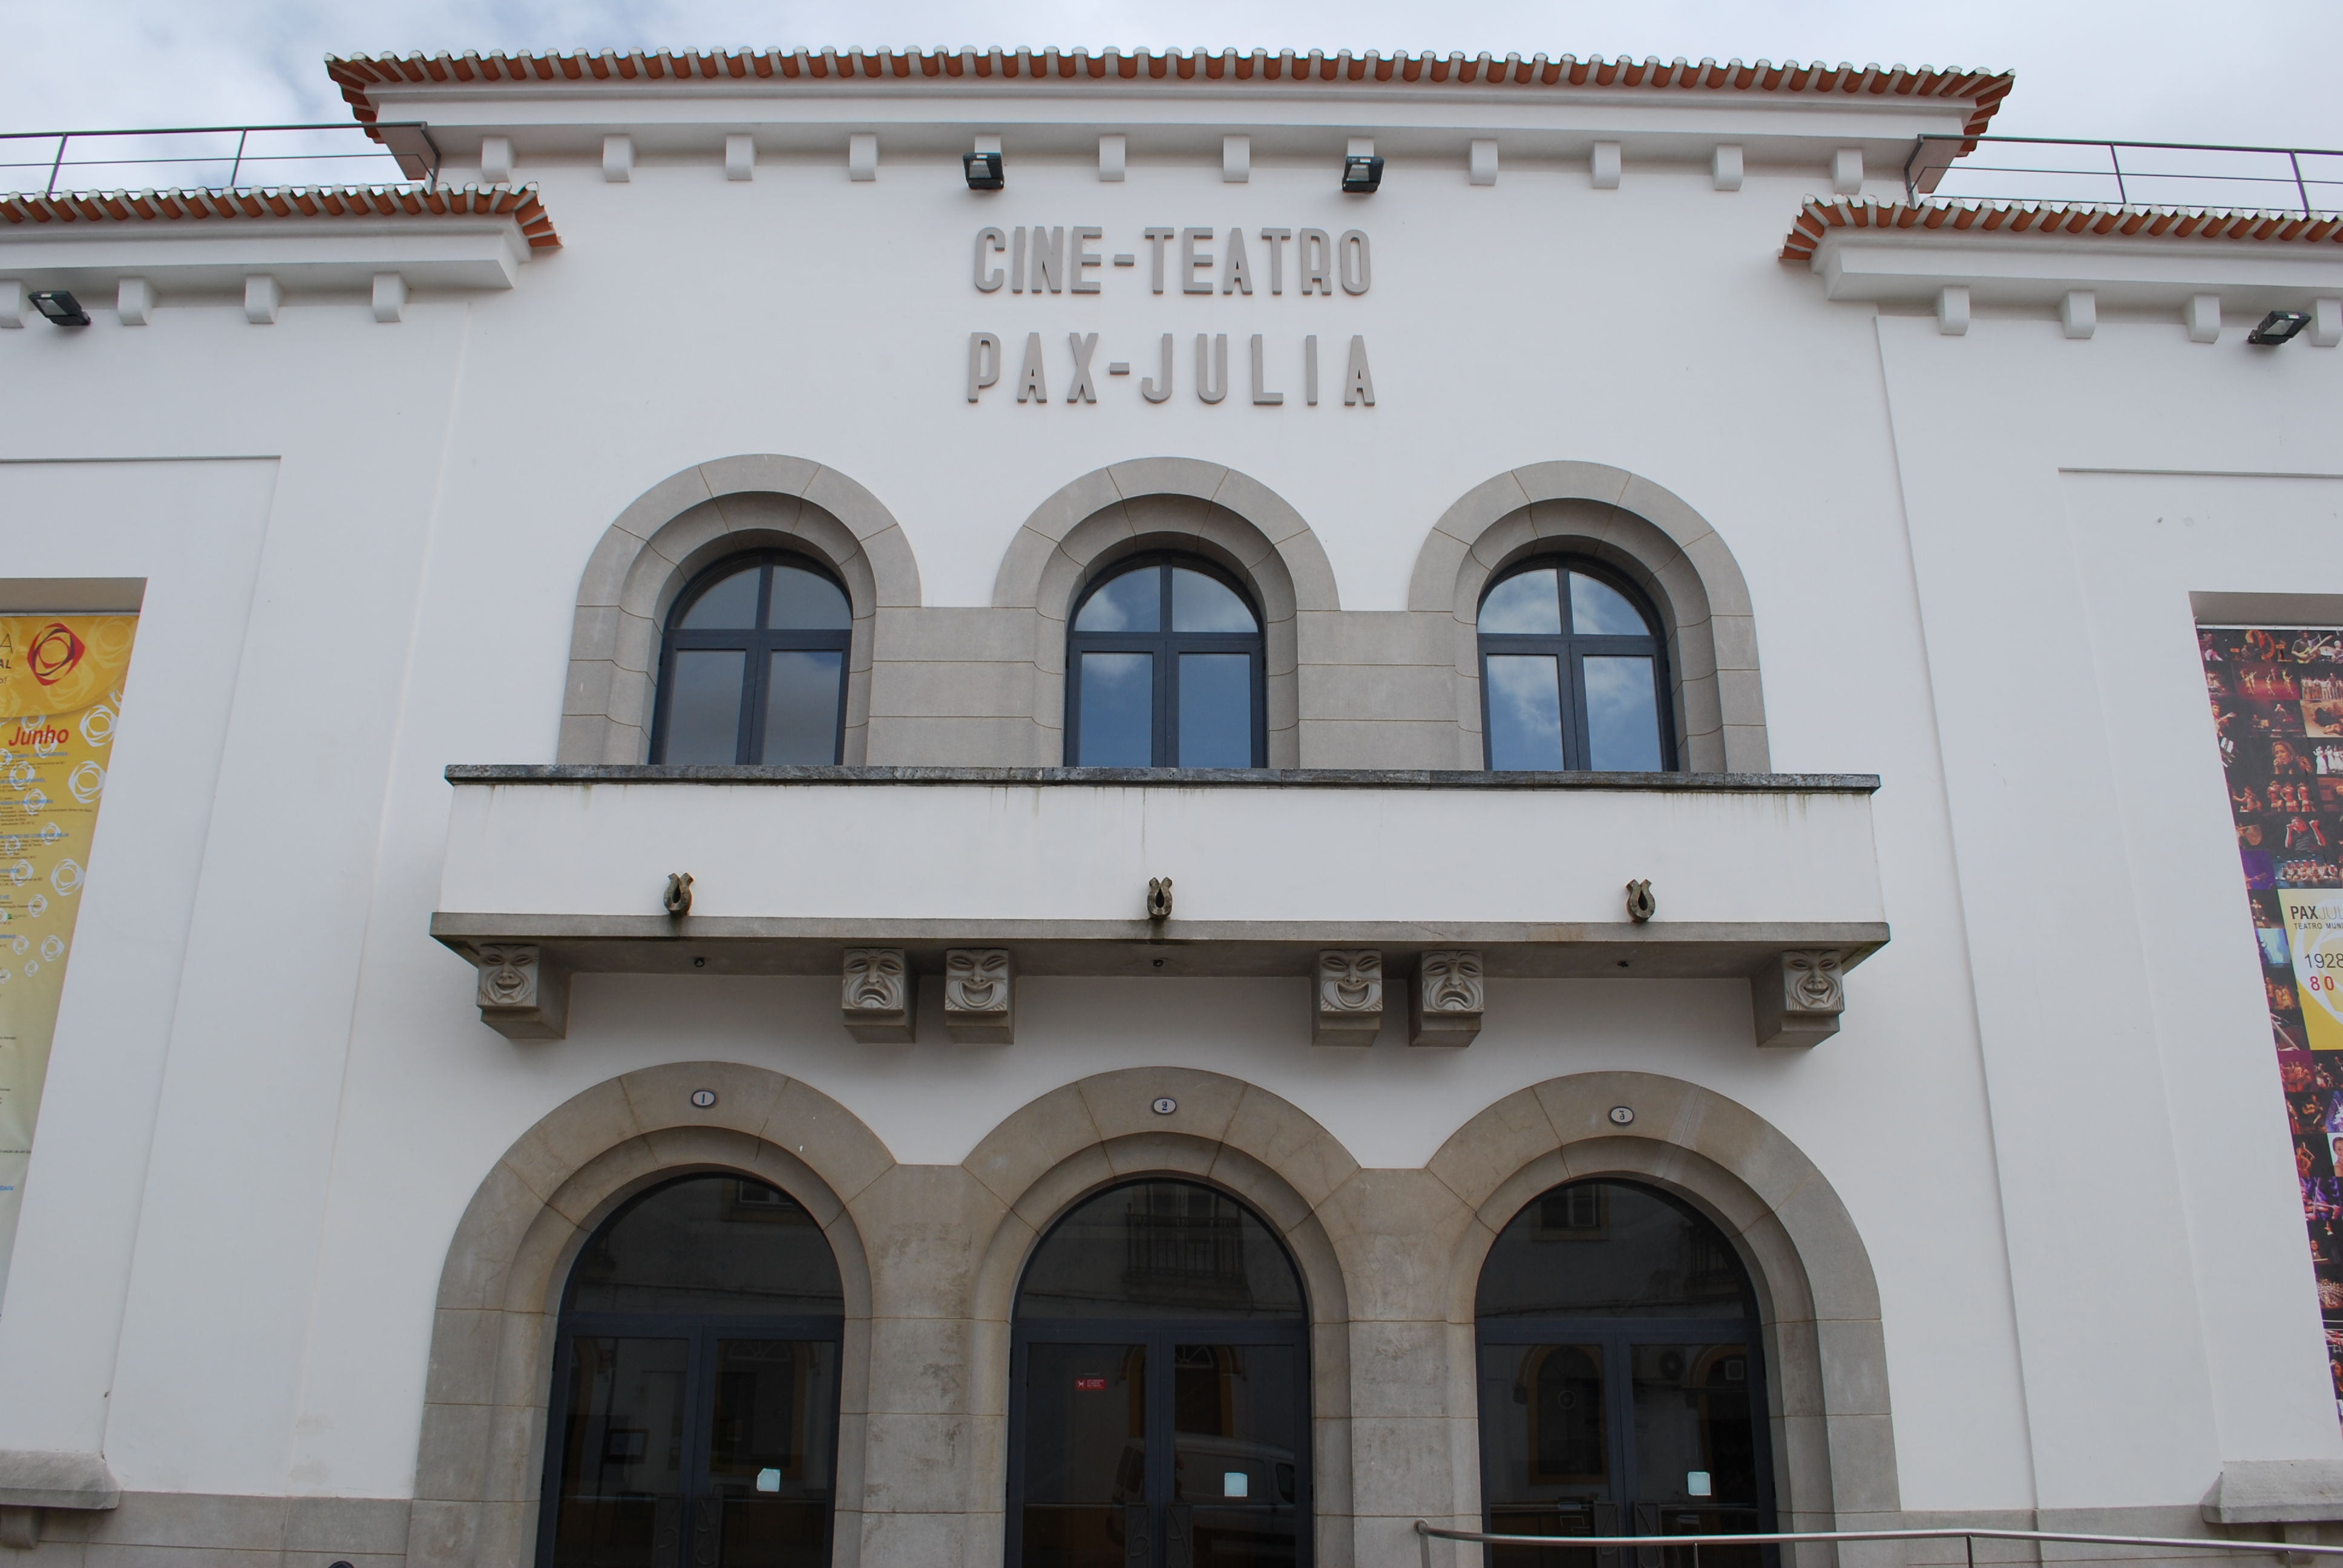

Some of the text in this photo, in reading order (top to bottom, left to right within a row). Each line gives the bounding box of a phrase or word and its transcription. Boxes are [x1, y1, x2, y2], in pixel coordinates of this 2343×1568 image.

[974, 226, 1372, 296] CINE-TEATRO
[968, 332, 1375, 406] PAX-JULIA
[8, 725, 69, 746] Junho
[1162, 1100, 1168, 1111] 2
